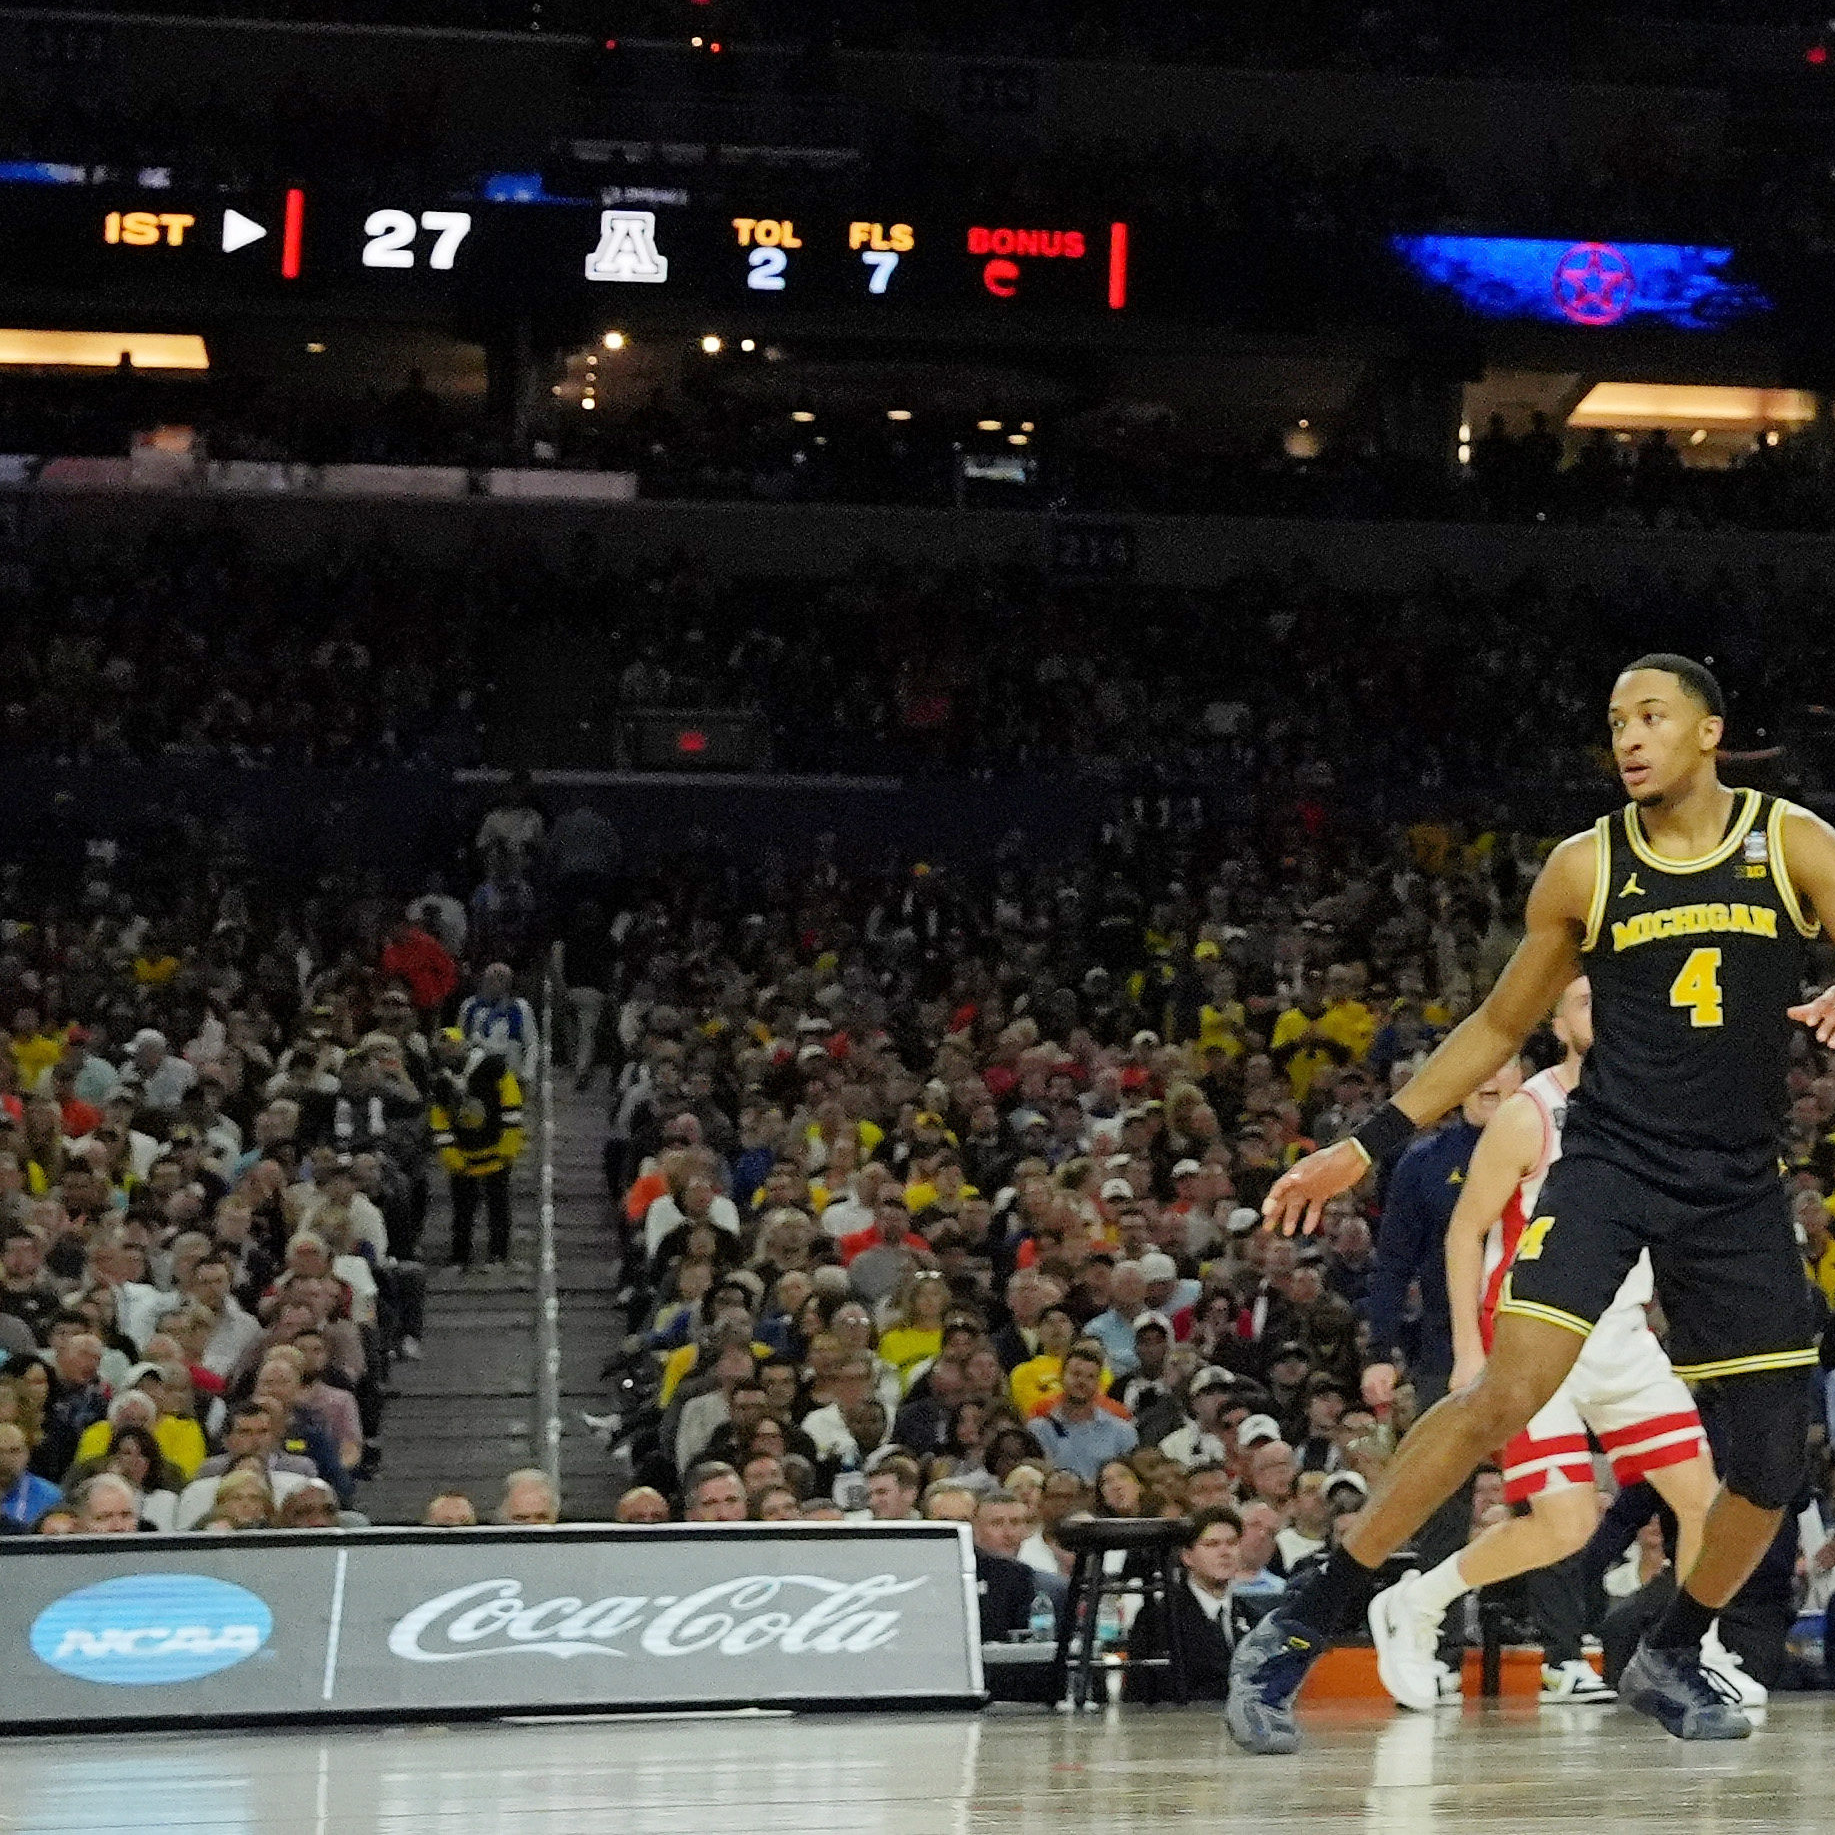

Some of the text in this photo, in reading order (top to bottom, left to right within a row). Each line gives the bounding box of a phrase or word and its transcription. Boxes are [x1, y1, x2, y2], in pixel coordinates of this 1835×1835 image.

[362, 208, 472, 270] 27
[731, 217, 803, 249] TOL
[848, 220, 916, 252] FLS
[966, 226, 1086, 258] BONUS
[746, 246, 788, 291] 2
[862, 250, 900, 294] 7
[1610, 902, 1779, 954] MICHIGAN
[1669, 947, 1725, 1029] 4
[388, 1572, 931, 1664] Coca-Cola
[52, 1623, 261, 1660] NCAA
